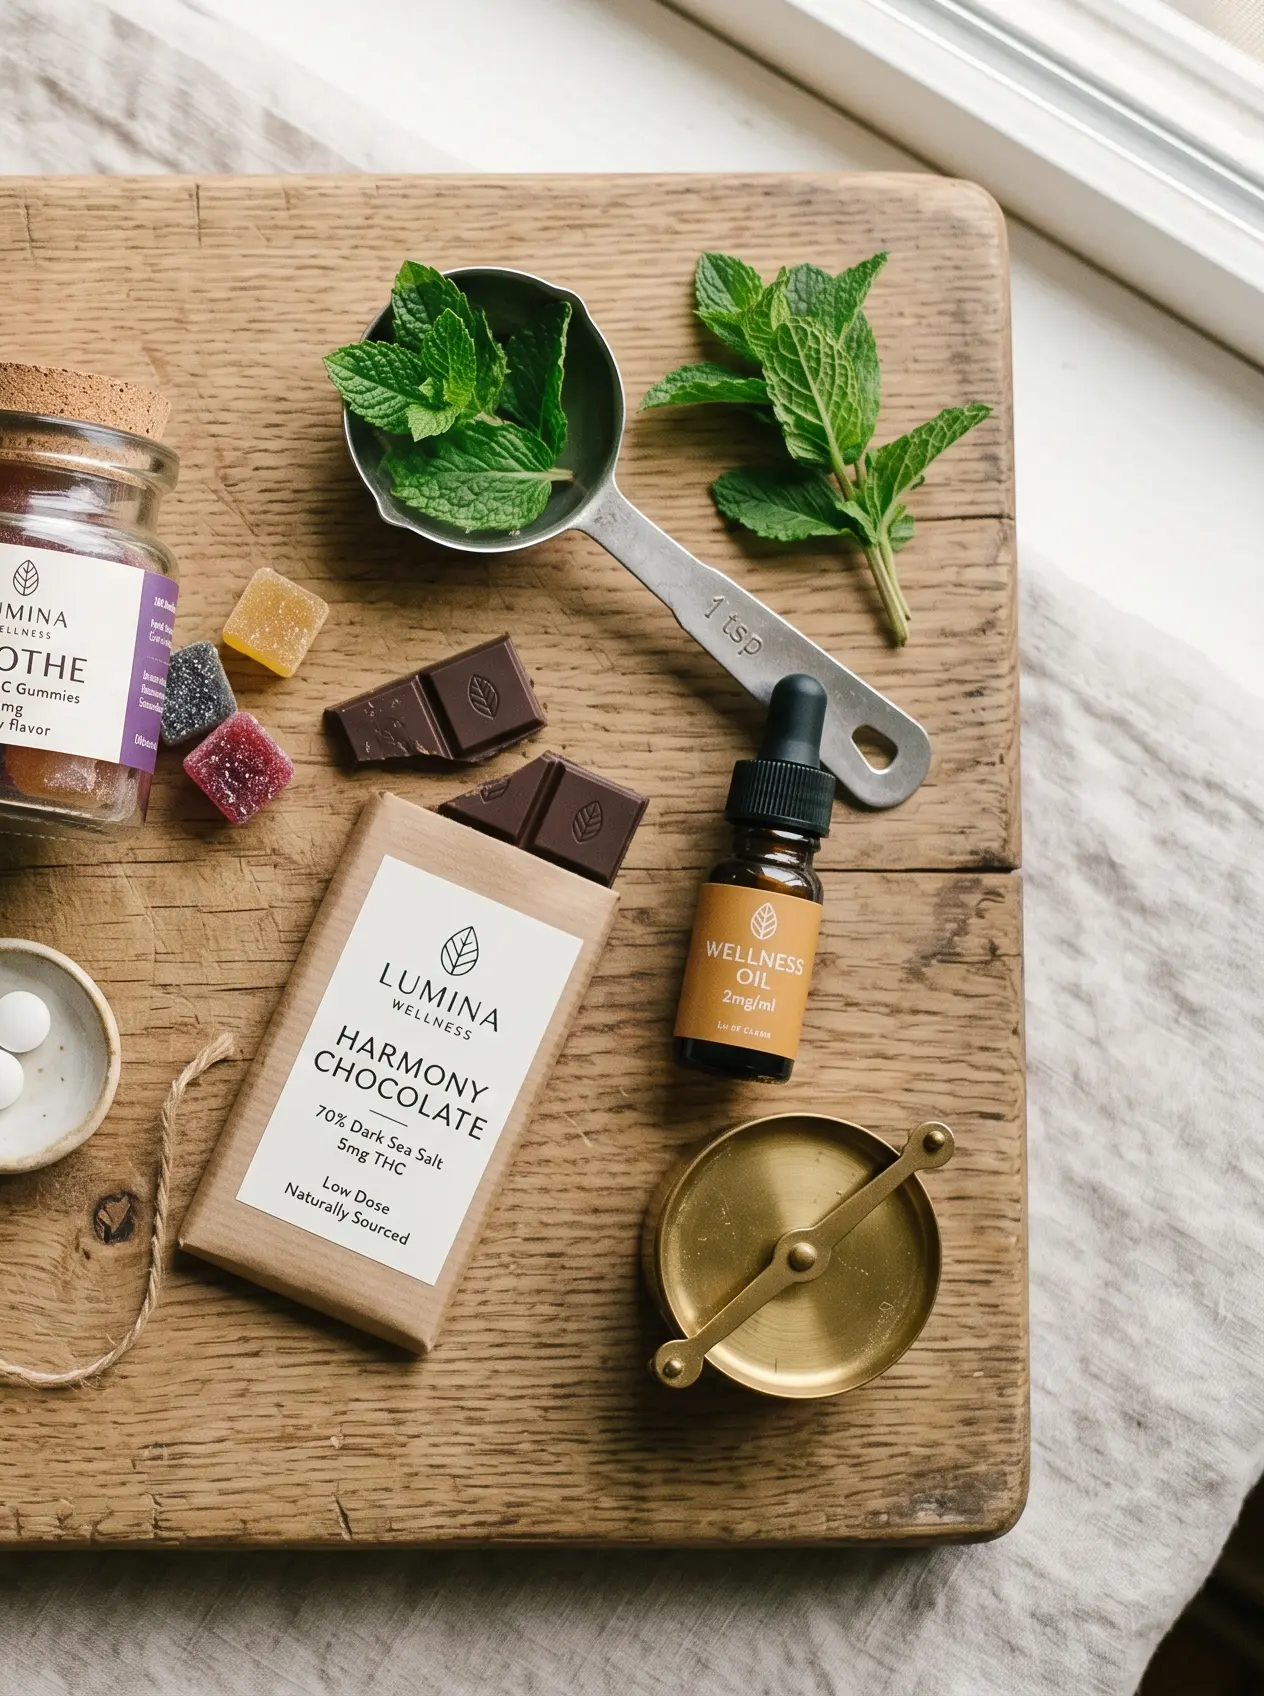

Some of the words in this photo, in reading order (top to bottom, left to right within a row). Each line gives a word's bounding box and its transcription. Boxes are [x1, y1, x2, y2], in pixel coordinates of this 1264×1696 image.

[704, 596, 724, 618] 1
[722, 614, 763, 655] tsp
[16, 679, 80, 704] Gummies
[8, 718, 51, 736] flavor
[706, 940, 805, 976] WELLNESS
[379, 962, 499, 1032] LUMINA
[736, 968, 771, 990] OIL
[391, 998, 472, 1041] WELLNESS
[722, 989, 776, 1012] 2mg/ml
[335, 1024, 489, 1104] HARMONY
[313, 1050, 488, 1140] CHOCOLATE
[315, 1104, 346, 1128] 70%
[350, 1119, 384, 1145] Dark
[387, 1135, 412, 1157] Sea
[415, 1147, 444, 1170] Salt
[337, 1137, 370, 1164] 5mg
[373, 1150, 406, 1176] THC
[284, 1182, 350, 1222] Naturally
[351, 1211, 410, 1246] Sourced
[322, 1175, 352, 1198] Low
[354, 1189, 390, 1215] Dose
